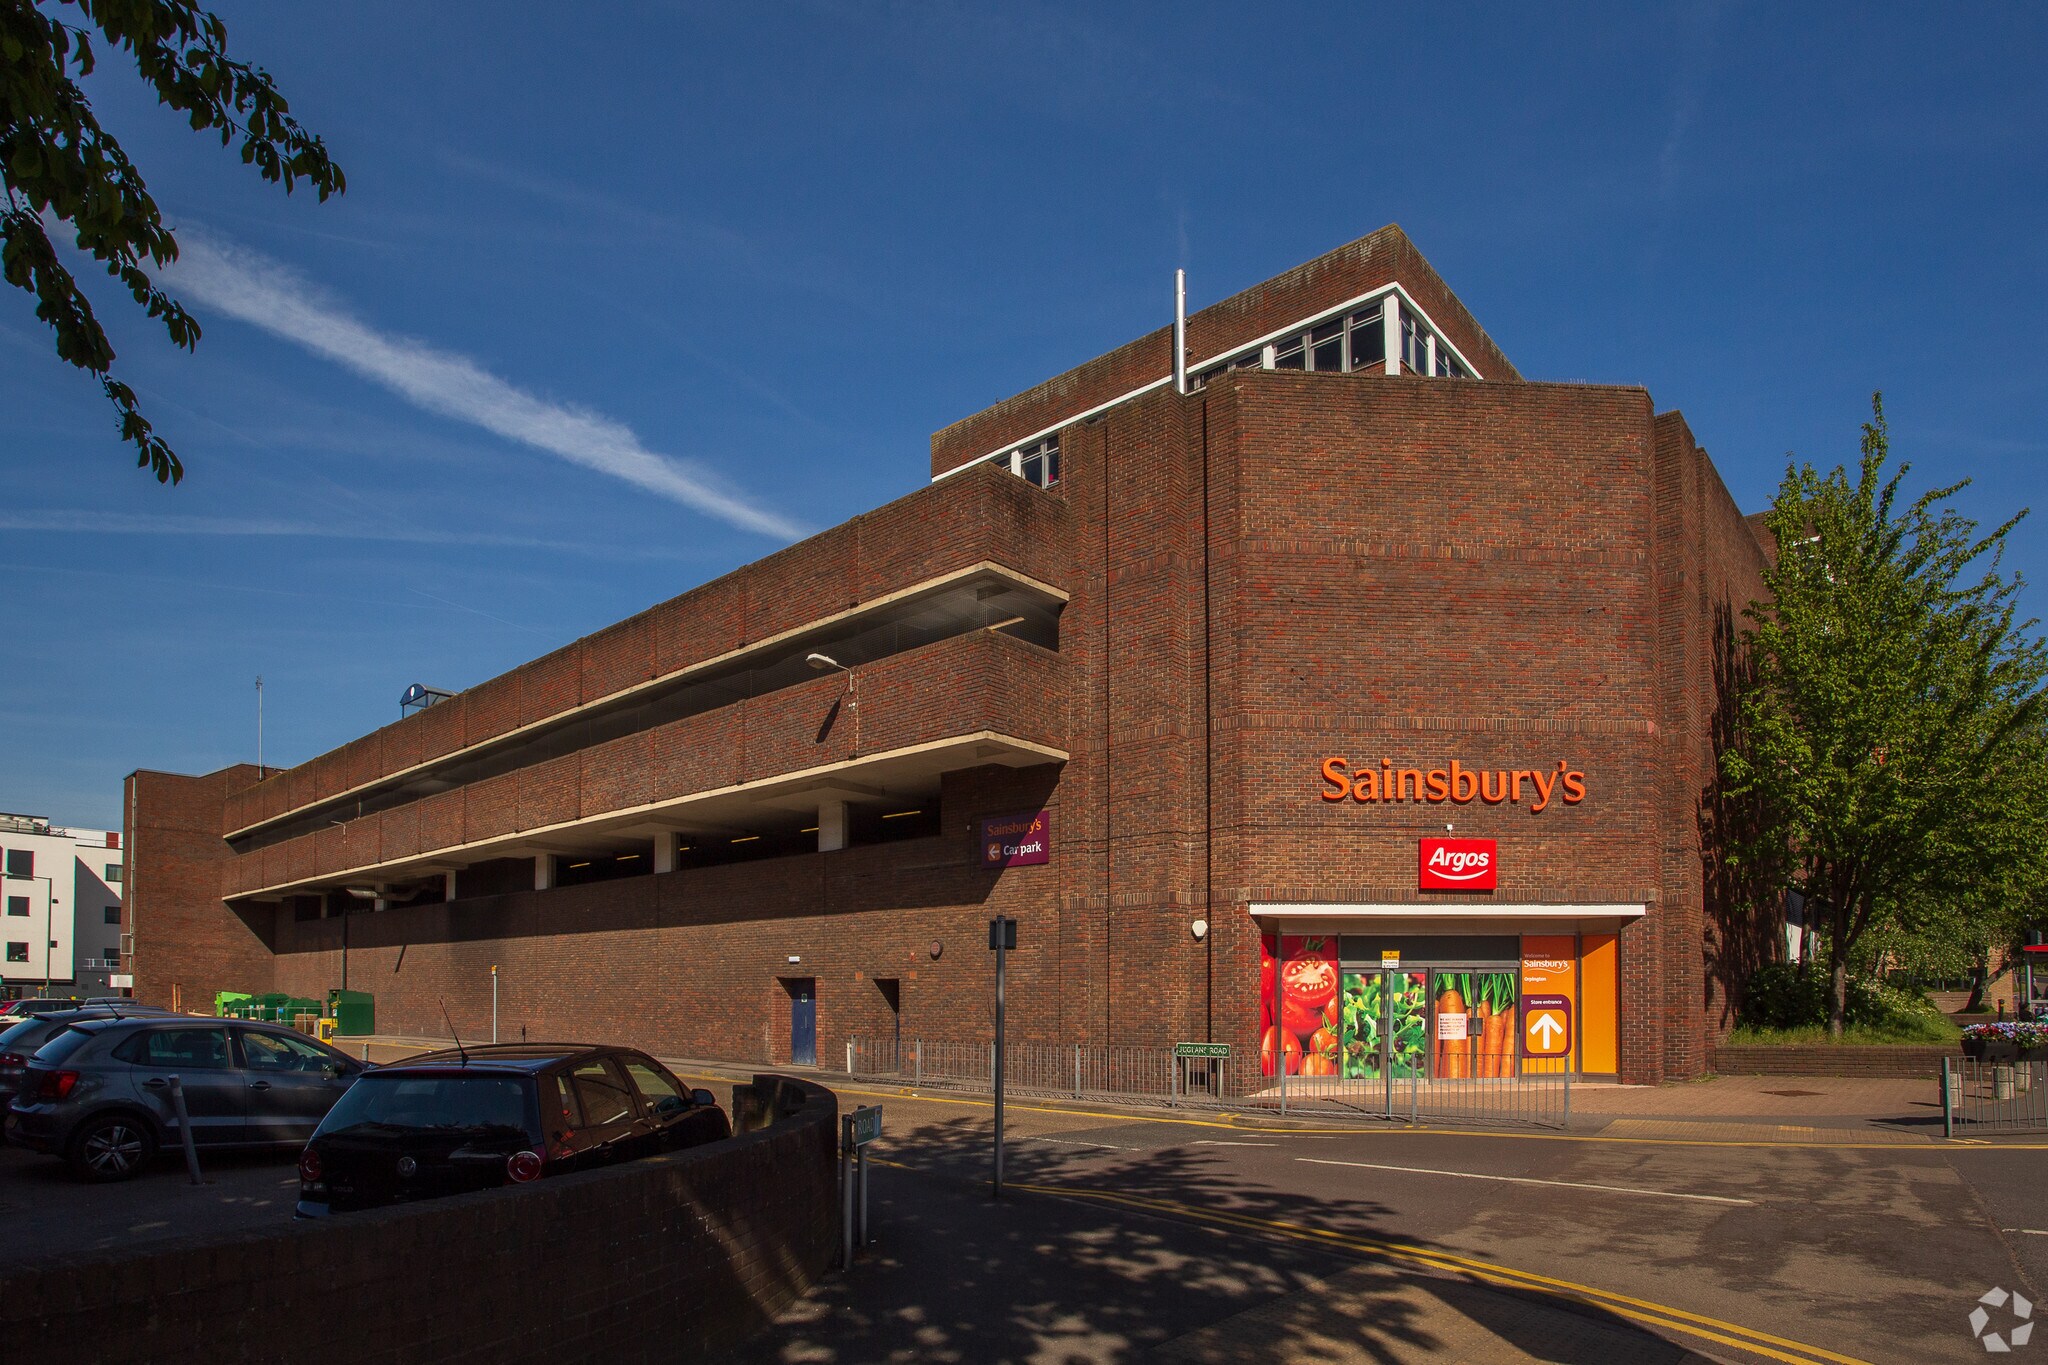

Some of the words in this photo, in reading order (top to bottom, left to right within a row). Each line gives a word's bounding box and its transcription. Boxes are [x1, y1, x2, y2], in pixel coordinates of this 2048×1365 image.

[1321, 757, 1586, 812] Sainsbury's
[987, 819, 1042, 837] Sainsbury's
[1003, 845, 1019, 856] Car
[1020, 841, 1042, 857] park
[1428, 847, 1489, 872] Argos
[1524, 959, 1568, 969] Sainsbury's
[1210, 1047, 1228, 1055] ROAD
[857, 1117, 875, 1136] ROAD
